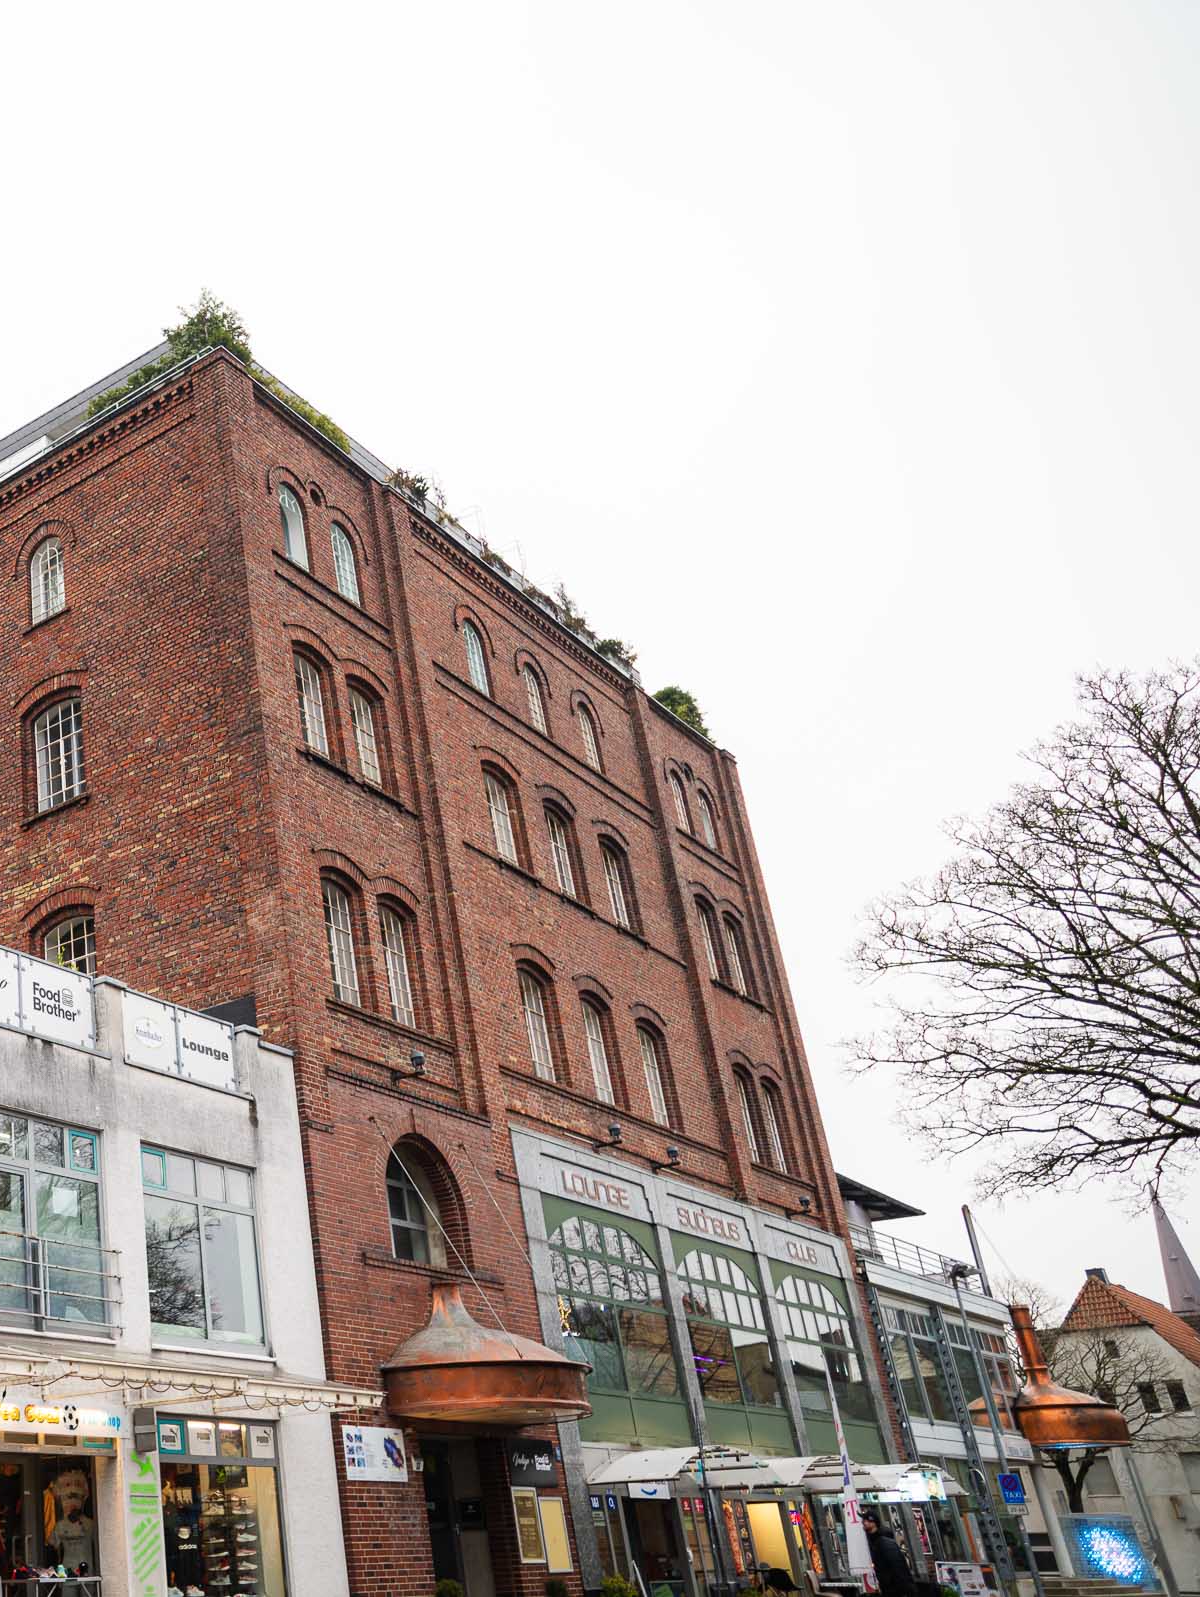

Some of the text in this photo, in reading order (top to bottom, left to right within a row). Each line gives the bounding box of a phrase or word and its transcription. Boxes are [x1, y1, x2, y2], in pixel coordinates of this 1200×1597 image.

[32, 981, 61, 1003] Food
[33, 996, 77, 1022] Brother
[182, 1037, 229, 1062] Lounge
